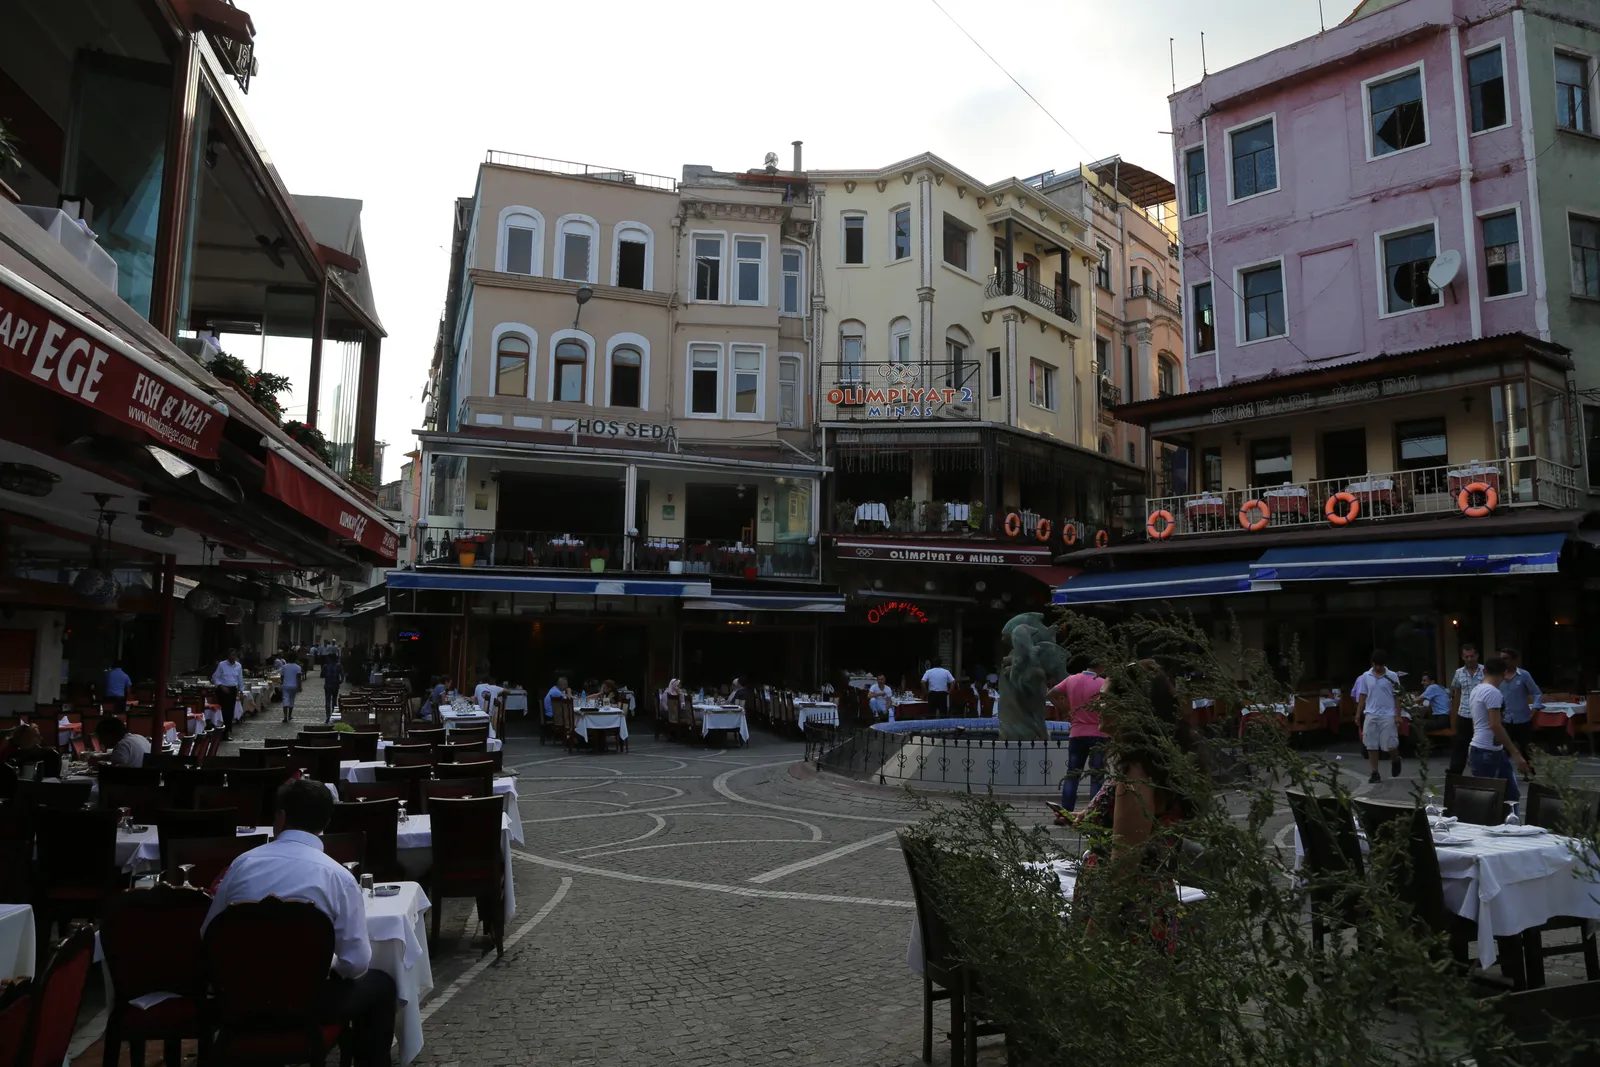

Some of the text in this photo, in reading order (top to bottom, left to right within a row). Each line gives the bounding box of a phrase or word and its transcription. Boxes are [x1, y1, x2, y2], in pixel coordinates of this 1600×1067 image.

[0, 303, 109, 403] API EGE
[132, 372, 164, 411] FISH
[174, 400, 211, 434] MEAT
[827, 384, 972, 404] OLİMPİYAT 2
[868, 404, 932, 417] MİNAS
[577, 418, 676, 440] HOŞ SEDA
[890, 549, 951, 562] OLİMPİYAT
[969, 554, 1005, 563] MİNAS
